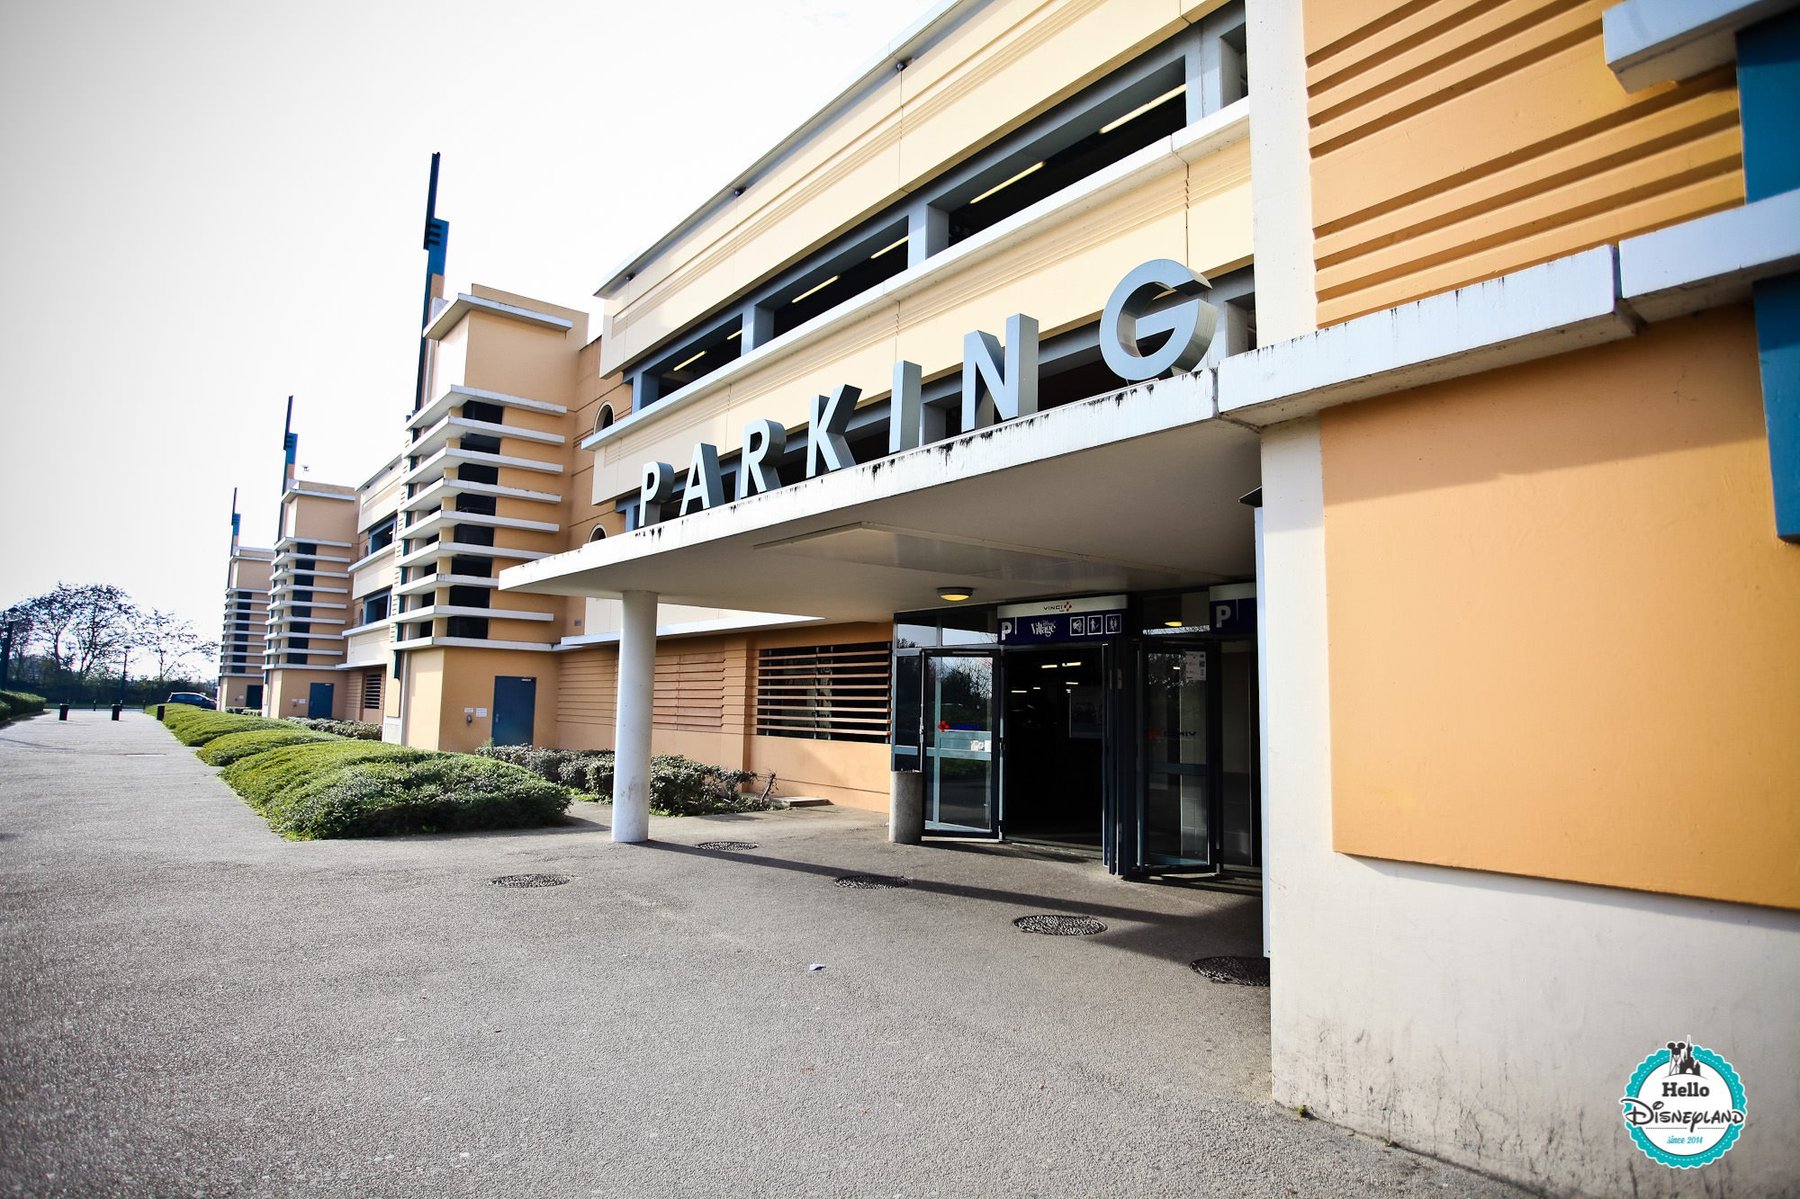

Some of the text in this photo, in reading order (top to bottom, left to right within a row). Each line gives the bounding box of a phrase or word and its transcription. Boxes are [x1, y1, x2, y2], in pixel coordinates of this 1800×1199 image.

[638, 258, 1217, 527] PARKING
[1216, 605, 1231, 628] P
[1001, 621, 1013, 641] P
